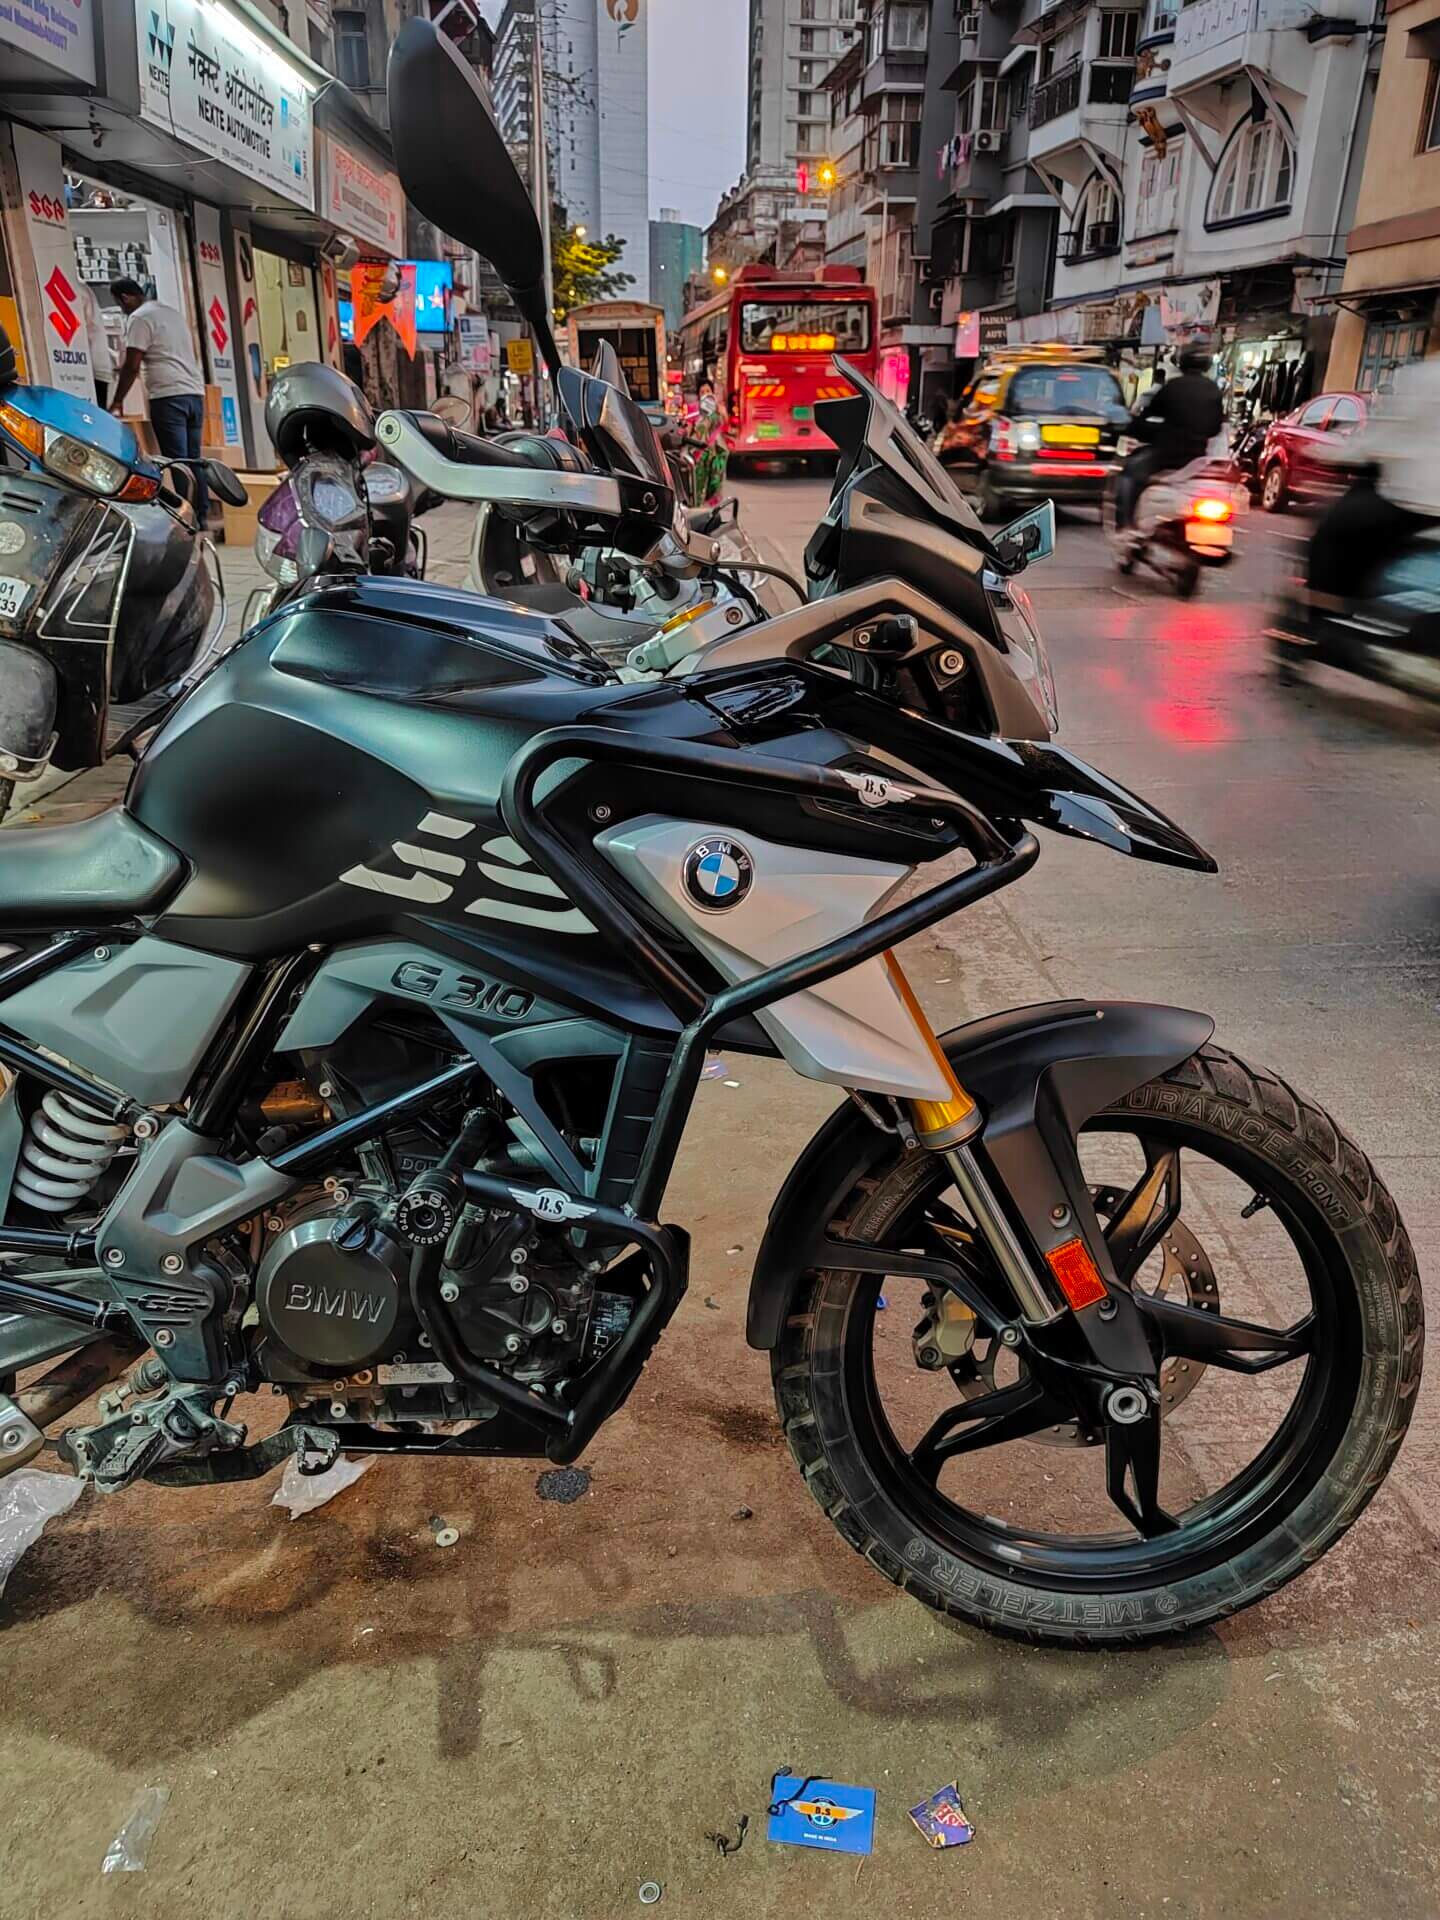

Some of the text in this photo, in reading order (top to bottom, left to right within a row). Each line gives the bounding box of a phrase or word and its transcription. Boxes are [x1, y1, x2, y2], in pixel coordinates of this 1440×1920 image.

[149, 63, 169, 88] NEXTE
[198, 95, 225, 132] NEXTE
[227, 114, 271, 159] AUTOMOTIVE
[53, 349, 87, 366] SUZUKI
[864, 779, 888, 797] B.S
[696, 841, 750, 871] BMW
[390, 960, 537, 1020] G 310
[1114, 1084, 1290, 1159] URANCE
[406, 1193, 442, 1210] B.S
[1288, 1160, 1350, 1220] FRONT
[400, 1206, 409, 1231] AUTO
[538, 1196, 565, 1215] B.S
[284, 1284, 386, 1324] BMW
[930, 1553, 1144, 1624] METZELER
